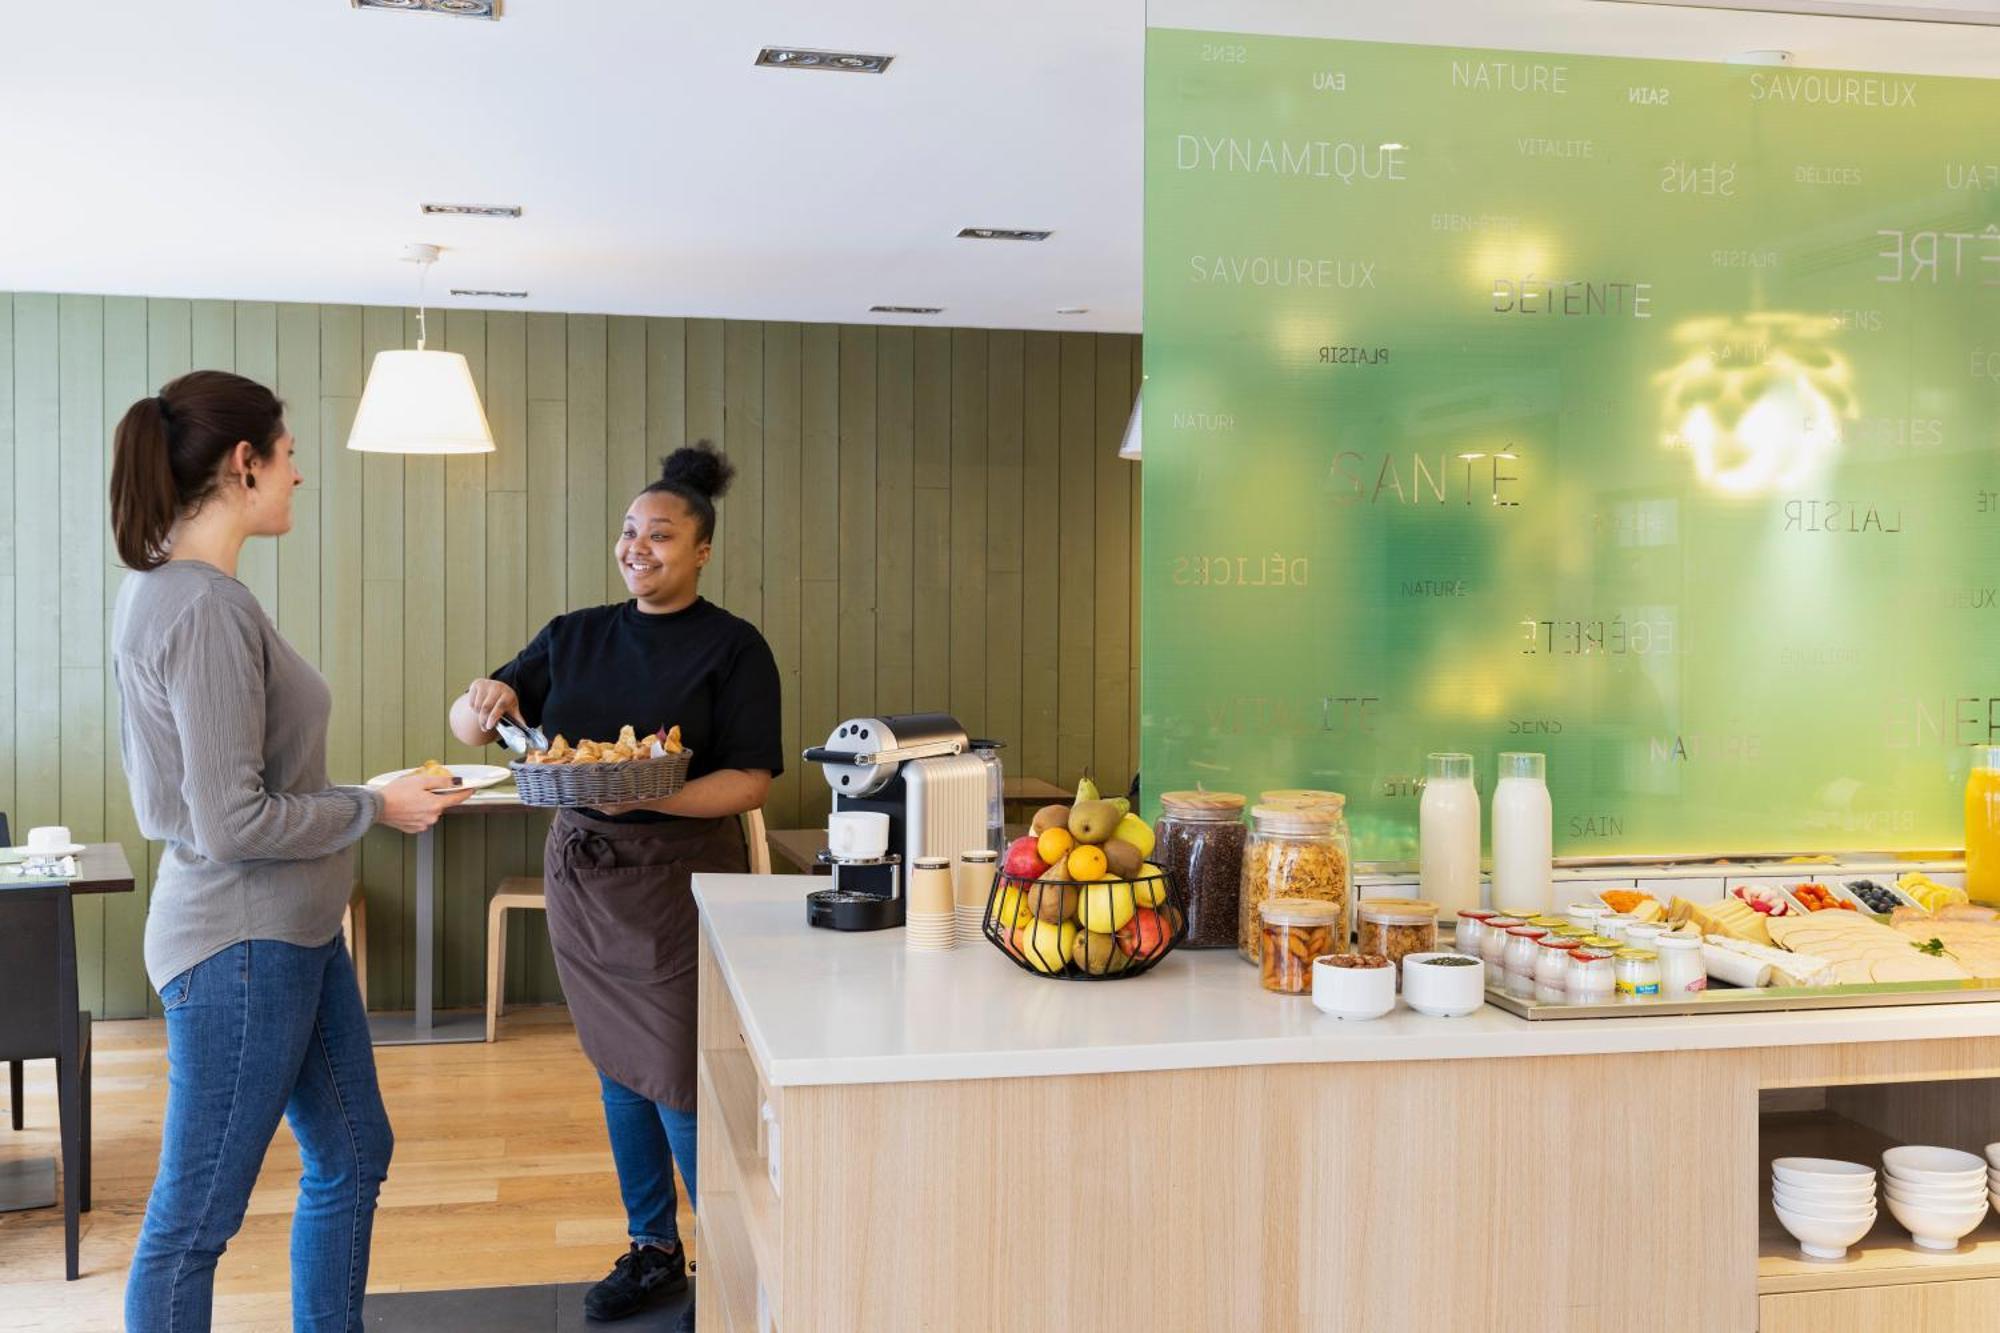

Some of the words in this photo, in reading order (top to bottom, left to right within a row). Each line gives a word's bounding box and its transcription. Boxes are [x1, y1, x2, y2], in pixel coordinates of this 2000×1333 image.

[1451, 61, 1568, 93] NATURE
[1750, 73, 1917, 107] SAVOUREUX
[1177, 135, 1407, 184] DYNAMIQUE
[1190, 255, 1376, 289] SAVOUREUX
[1493, 273, 1652, 317] DÉTENTE
[1327, 442, 1520, 507] SANTÉ
[1401, 580, 1467, 597] NATURE
[1568, 816, 1625, 838] SAIN
